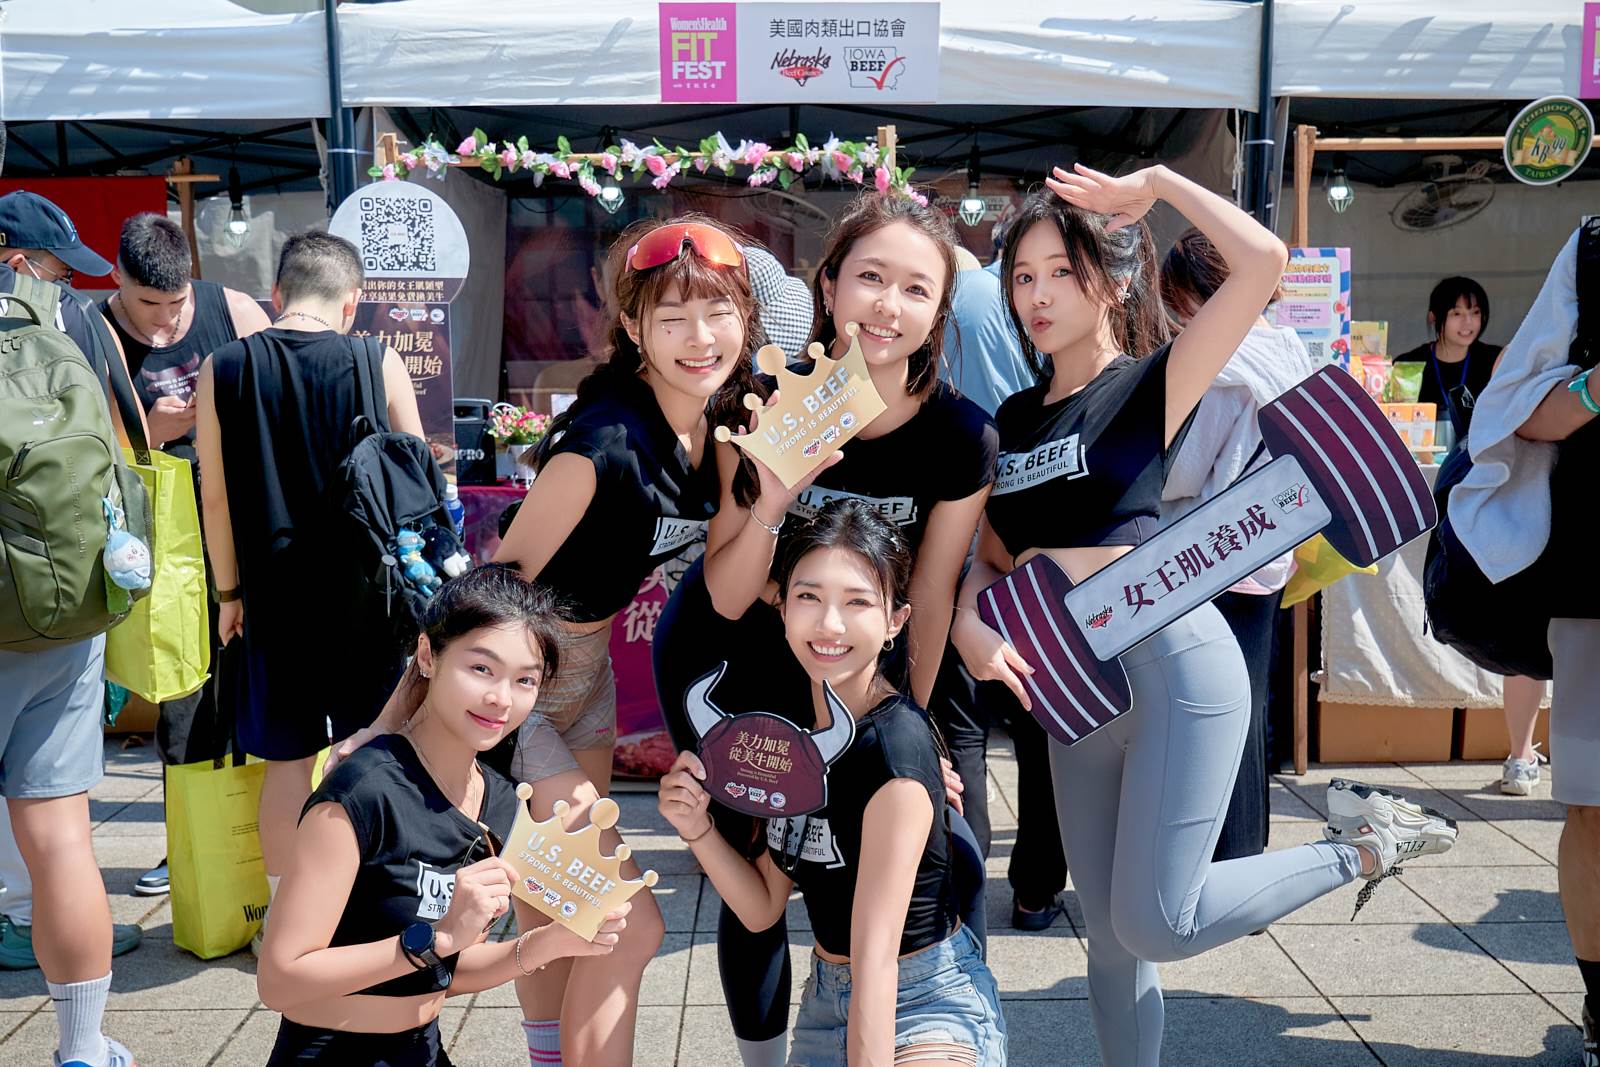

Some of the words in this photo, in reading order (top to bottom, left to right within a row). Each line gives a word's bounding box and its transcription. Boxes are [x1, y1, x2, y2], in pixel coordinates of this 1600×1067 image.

[769, 18, 907, 38] 美國肉類出口協會
[672, 32, 718, 61] FIT
[770, 46, 832, 69] Nebraska
[849, 48, 886, 60] IOWA
[672, 61, 726, 79] FEST
[849, 60, 885, 71] BEEF
[763, 412, 805, 446] U.S.
[802, 366, 851, 415] BEEF
[776, 428, 808, 456] STRONG
[808, 419, 818, 430] IS
[1025, 441, 1070, 471] BEEF
[1017, 476, 1025, 485] IS
[1028, 460, 1069, 482] BEAUTIFUL
[1278, 492, 1298, 508] BEEF
[1119, 504, 1277, 620] 女王肌養成
[732, 731, 791, 755] 美力加冕
[729, 746, 793, 773] 從美牛開始
[1395, 840, 1427, 854] FILA
[527, 831, 562, 868] U.S.
[566, 857, 616, 896] BEEF
[518, 850, 551, 874] STRONG
[551, 871, 561, 880] IS
[562, 878, 601, 910] BEAUTIFUL
